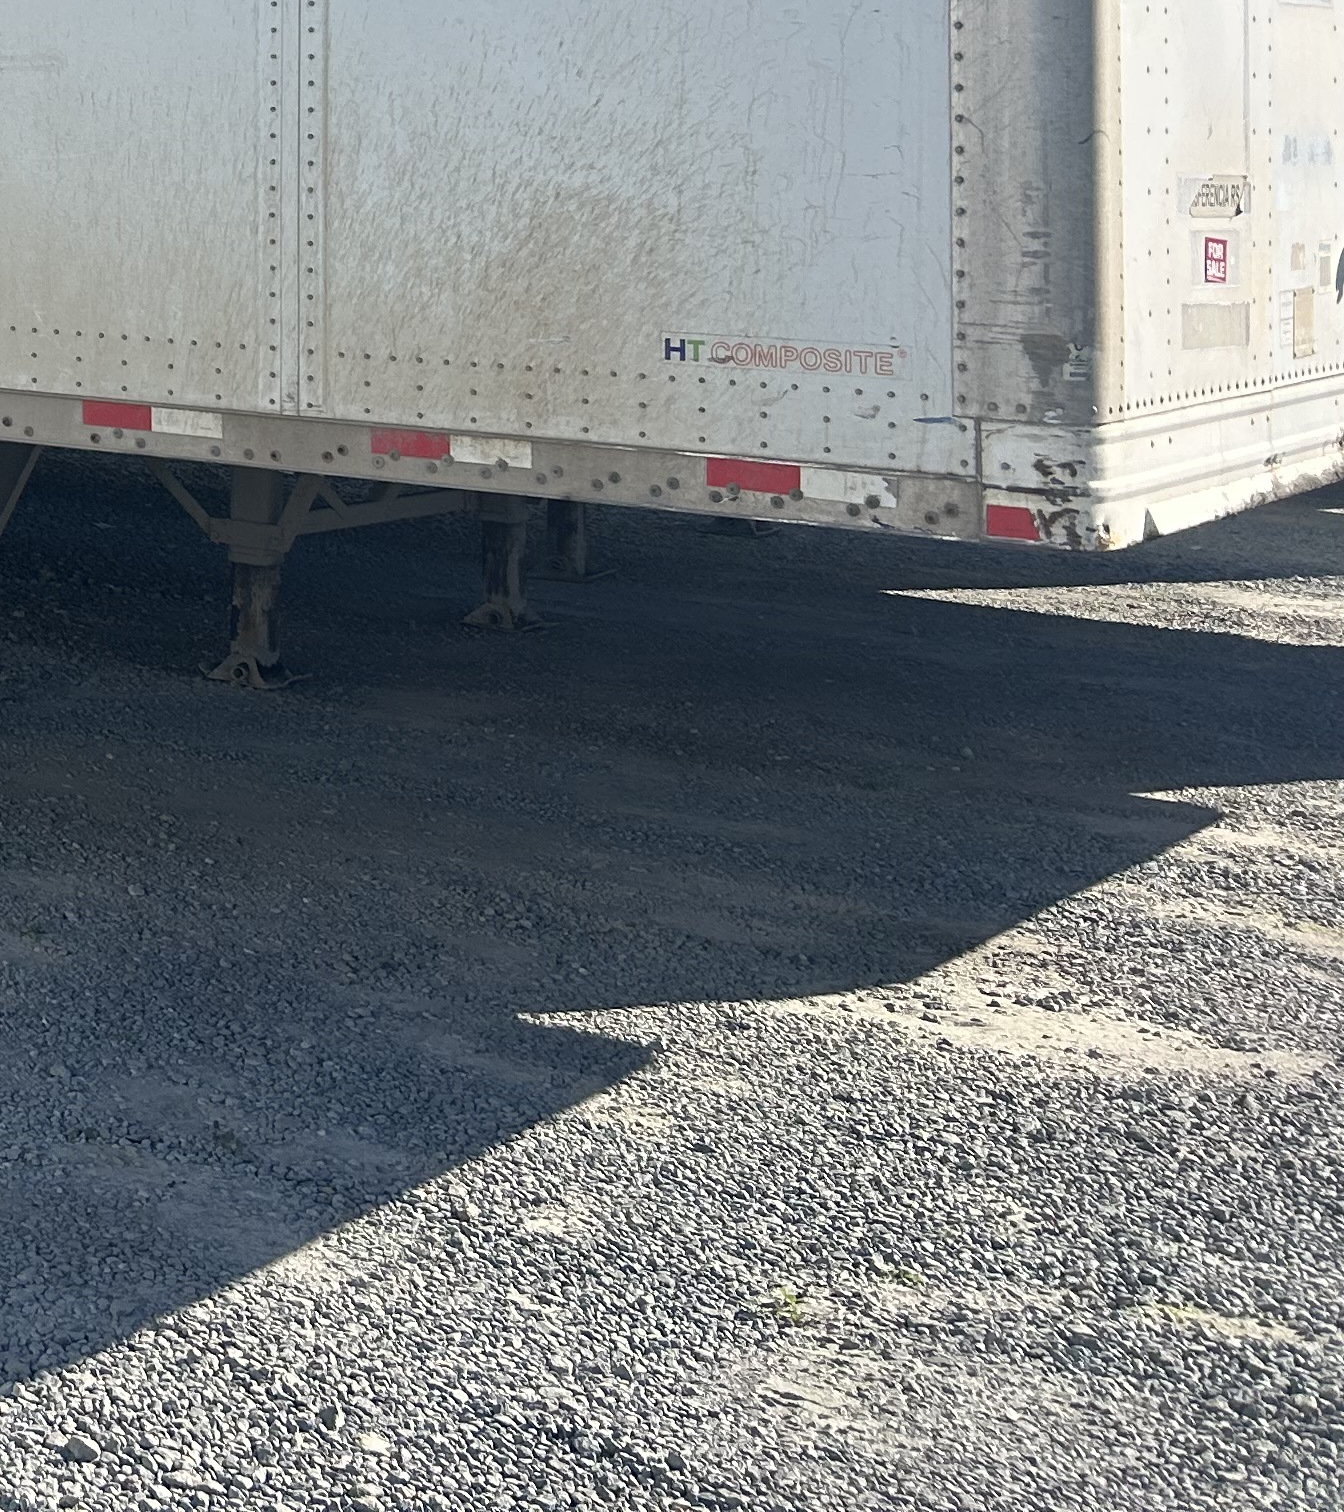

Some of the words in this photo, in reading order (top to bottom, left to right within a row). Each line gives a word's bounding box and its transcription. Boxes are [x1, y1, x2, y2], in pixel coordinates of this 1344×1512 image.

[1207, 242, 1224, 259] FOR
[1206, 259, 1226, 278] SALE
[664, 338, 706, 362] HT
[710, 341, 894, 376] COMPOSITE
